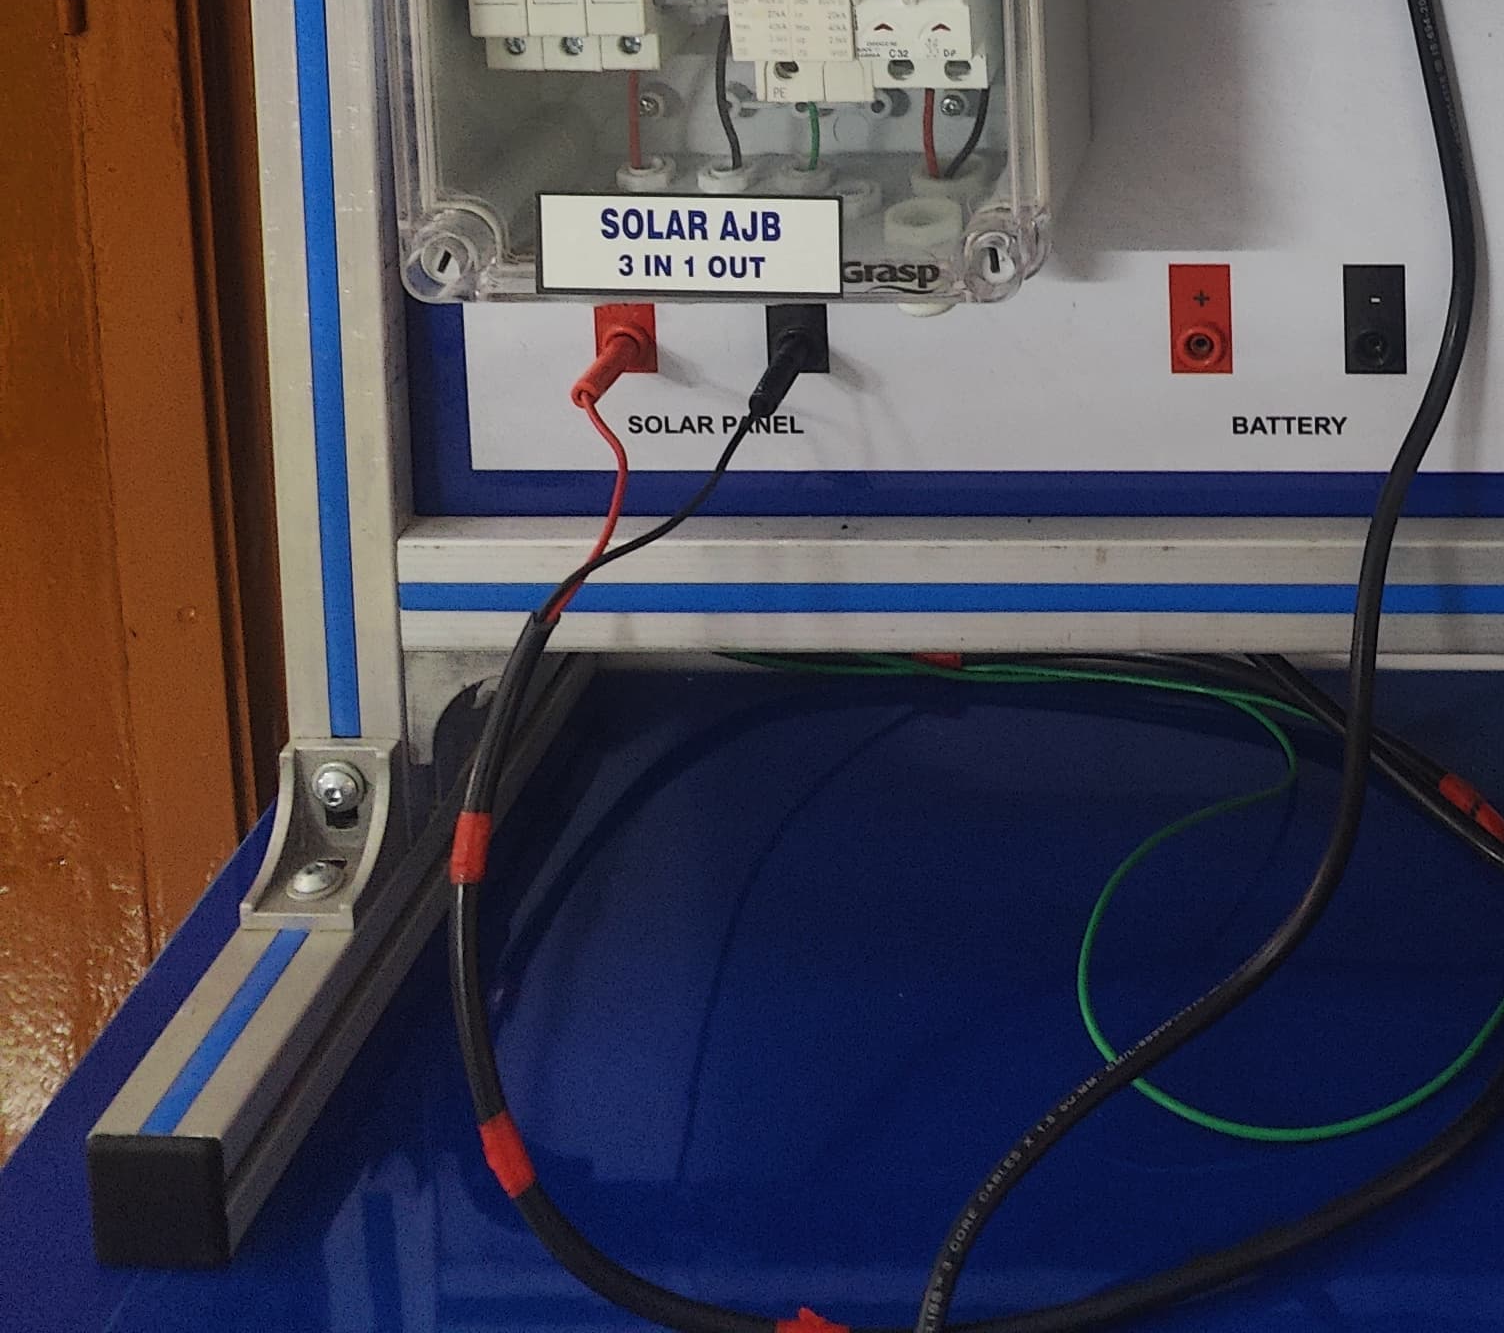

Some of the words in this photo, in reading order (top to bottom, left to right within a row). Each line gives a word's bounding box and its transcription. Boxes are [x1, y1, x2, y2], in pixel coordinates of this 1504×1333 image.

[600, 207, 708, 241] SOLAR
[719, 210, 782, 242] AJB
[618, 255, 634, 276] 3
[644, 255, 671, 276] IN
[684, 256, 695, 277] 1
[708, 256, 766, 279] OUT
[842, 261, 940, 289] Grasp
[628, 415, 714, 434] SOLAR
[722, 415, 804, 434] PANEL
[1231, 416, 1348, 437] BATTERY
